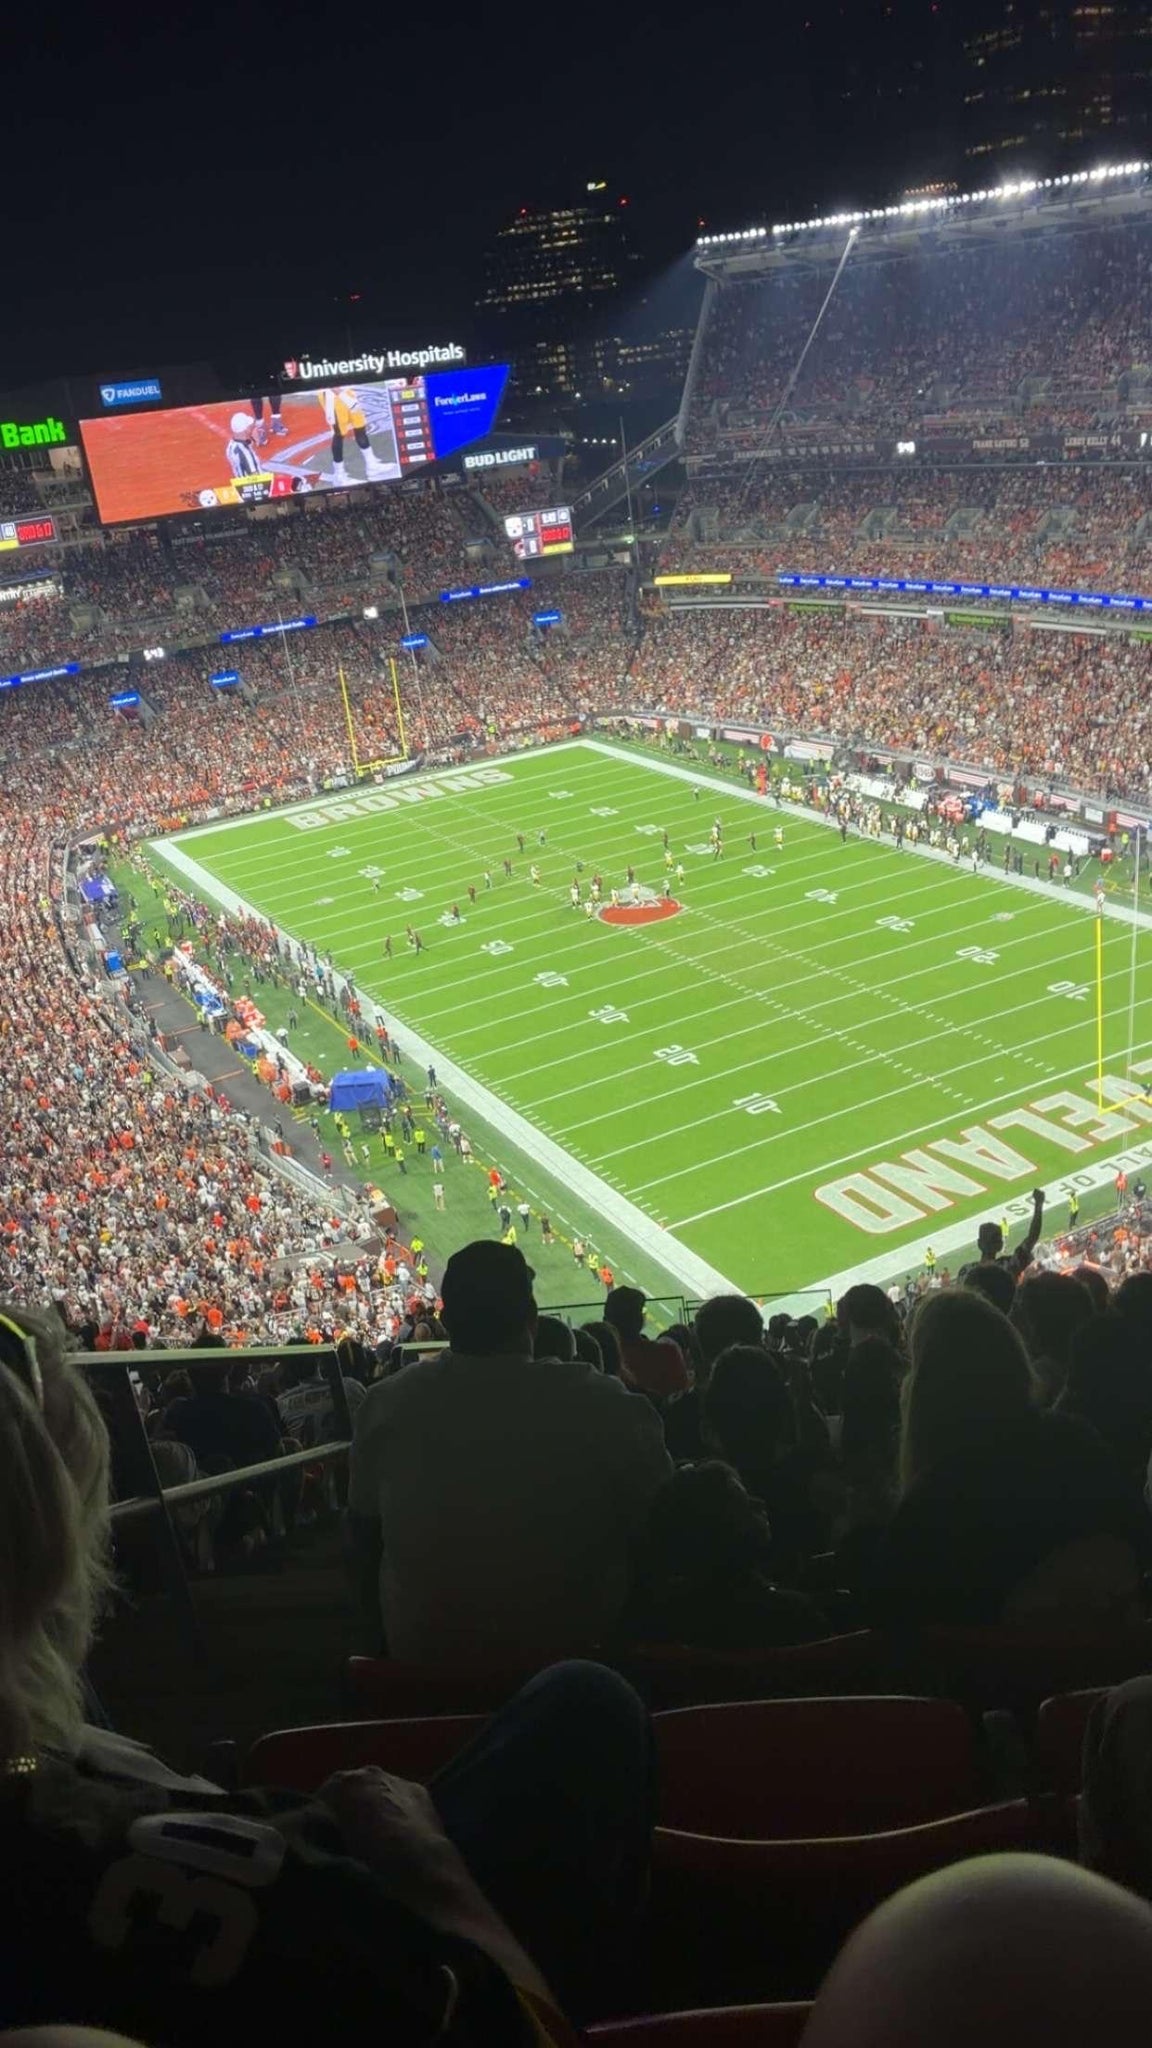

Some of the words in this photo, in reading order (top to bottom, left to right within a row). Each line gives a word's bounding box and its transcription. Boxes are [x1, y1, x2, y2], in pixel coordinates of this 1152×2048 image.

[300, 353, 385, 379] University
[387, 342, 464, 367] Hospitals
[117, 385, 160, 399] FANDUEL
[1, 417, 66, 448] Bank
[464, 453, 495, 469] BUD
[495, 447, 536, 464] LIGHT
[284, 768, 515, 830] BROWNS
[587, 1004, 627, 1024] 30
[653, 1044, 696, 1066] 20
[733, 1092, 777, 1115] 10
[814, 1058, 1152, 1234] VELAND
[1059, 1174, 1096, 1196] OF
